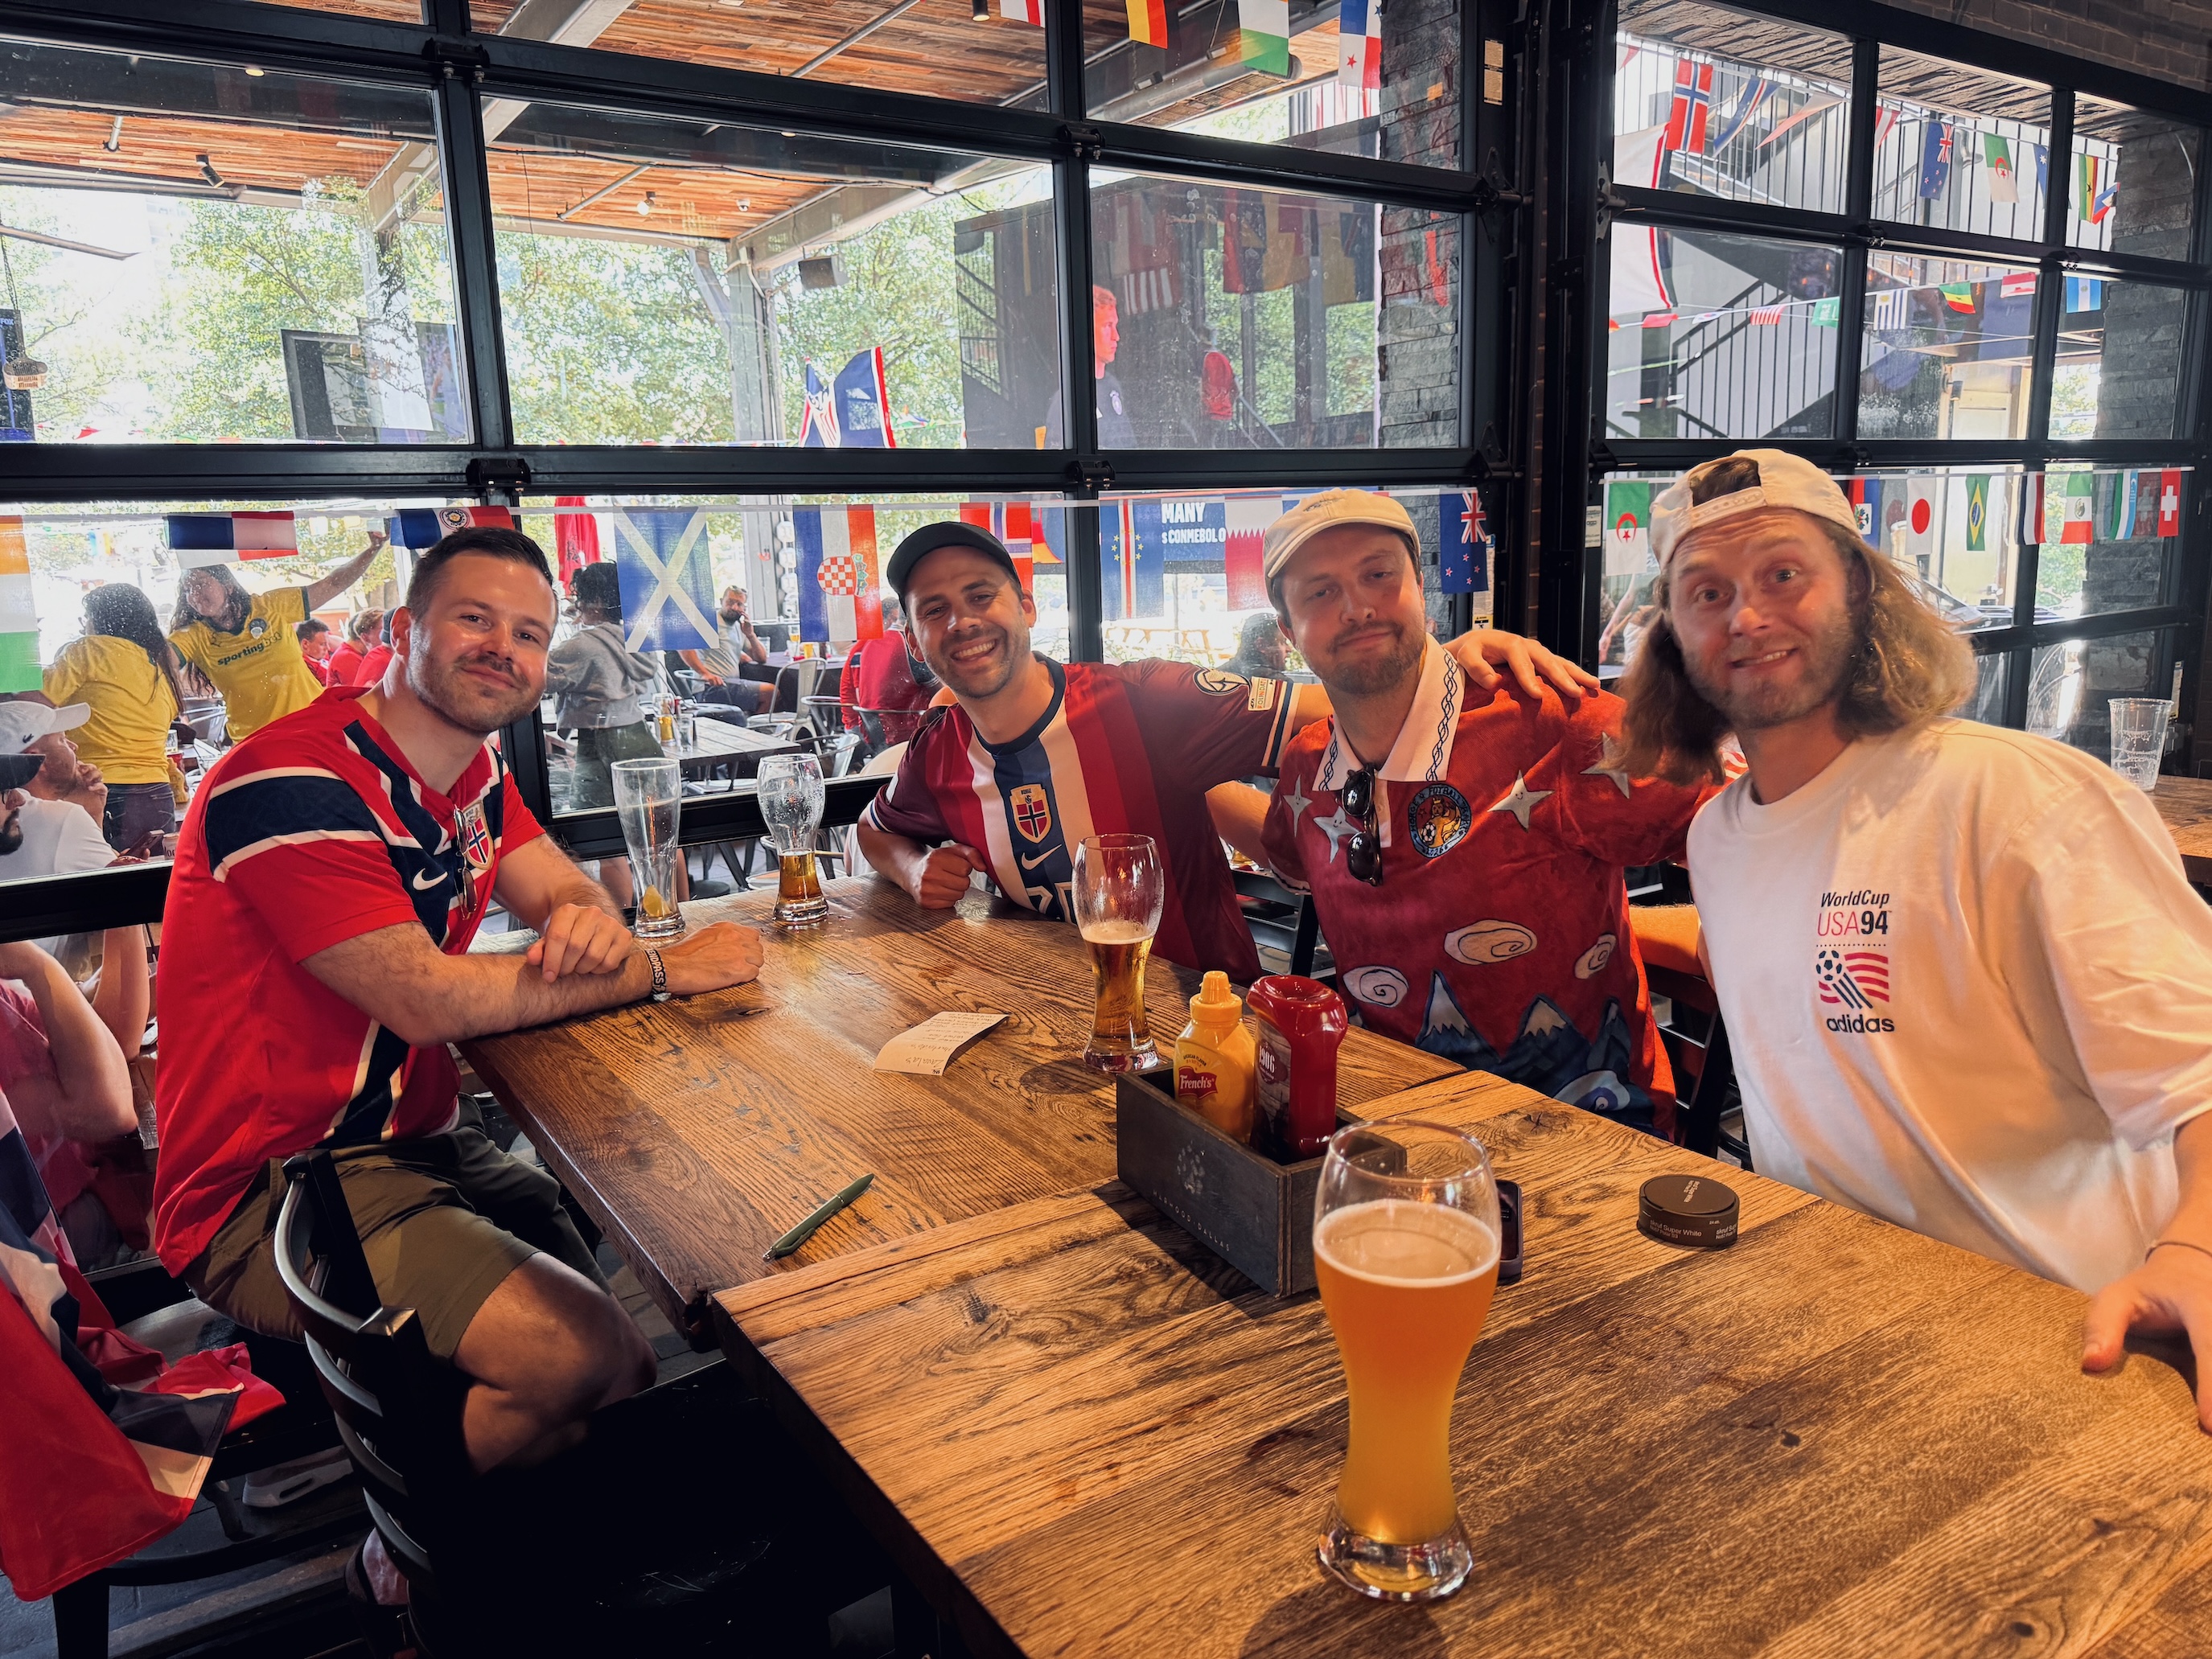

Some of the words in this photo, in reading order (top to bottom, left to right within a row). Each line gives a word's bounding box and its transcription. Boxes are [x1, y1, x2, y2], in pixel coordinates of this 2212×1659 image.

[648, 948, 664, 983] ENDPASS
[1827, 1014, 1894, 1033] adidas
[1260, 1045, 1275, 1074] 1906
[1180, 1074, 1213, 1090] French's
[1663, 1224, 1682, 1235] Super
[1683, 1229, 1702, 1237] White
